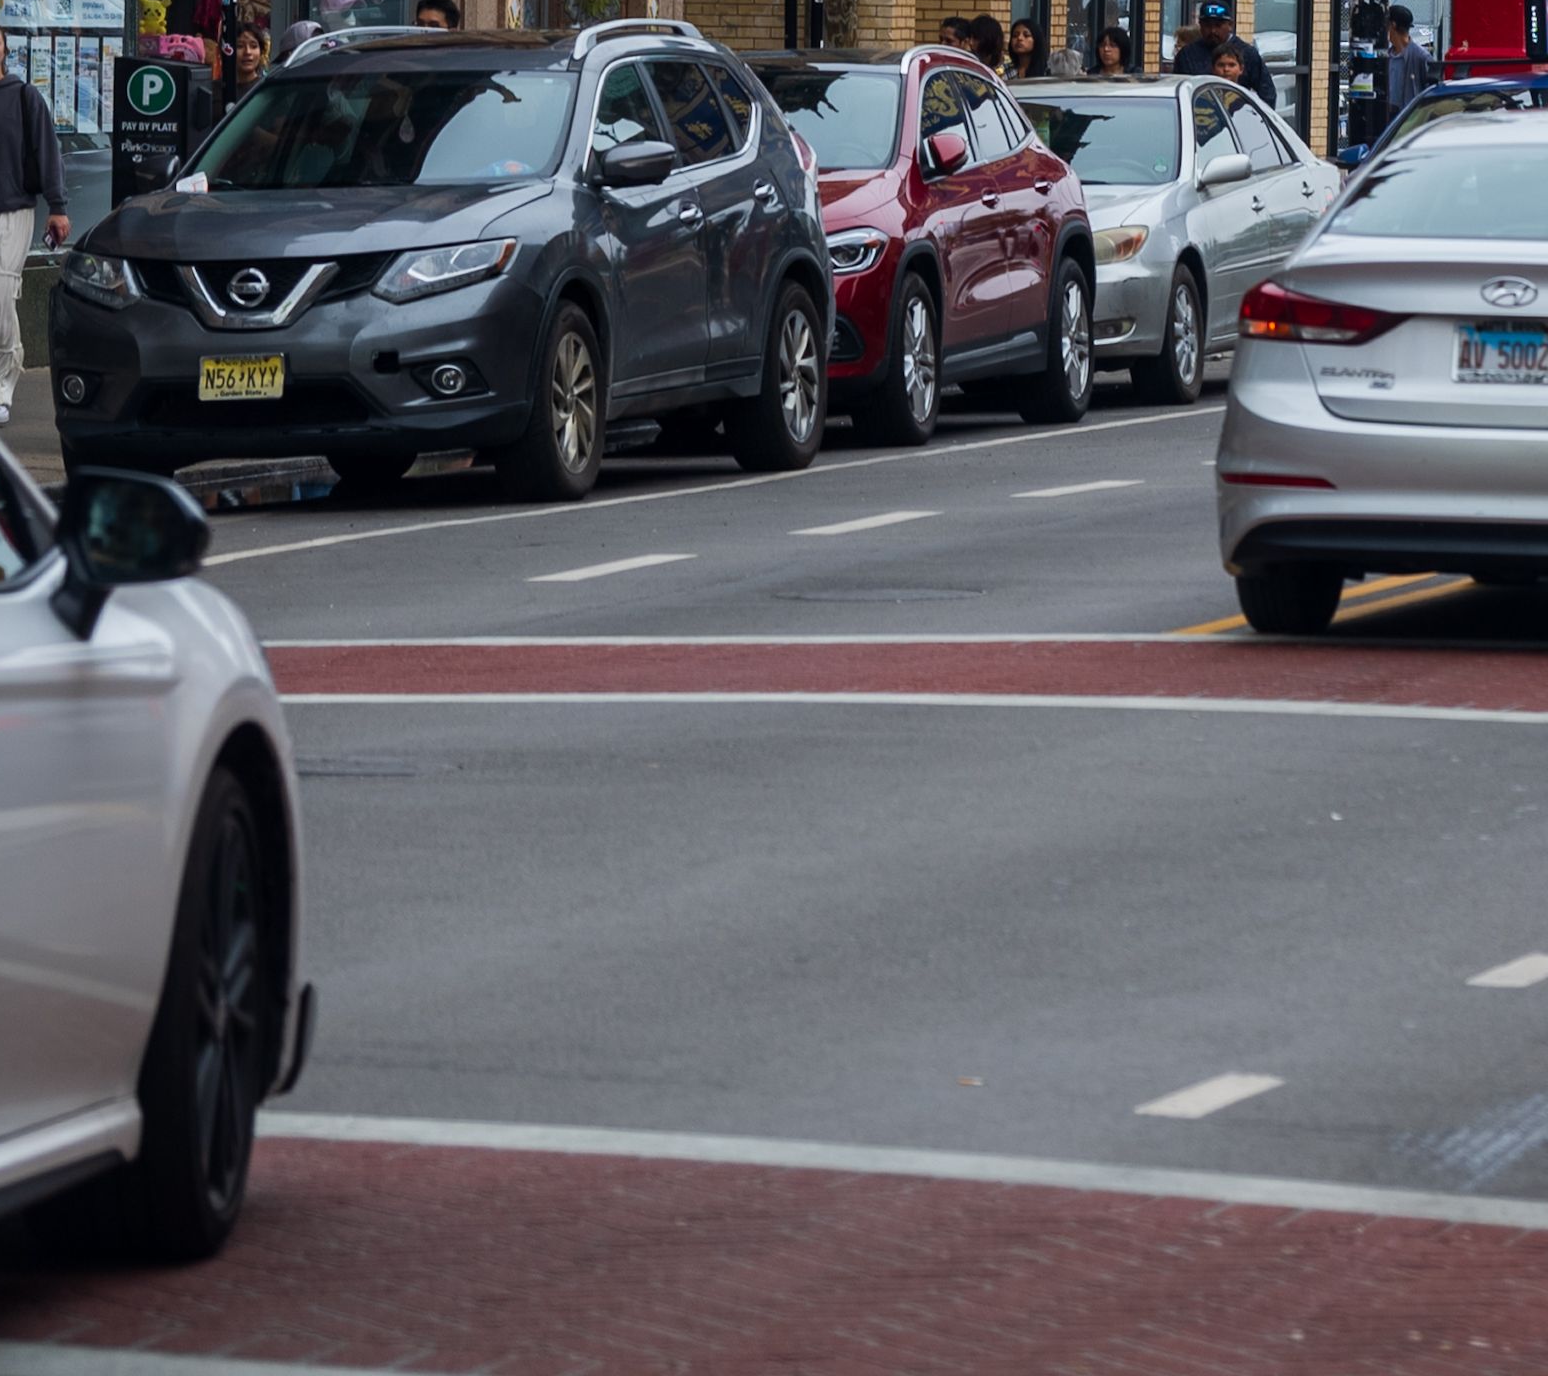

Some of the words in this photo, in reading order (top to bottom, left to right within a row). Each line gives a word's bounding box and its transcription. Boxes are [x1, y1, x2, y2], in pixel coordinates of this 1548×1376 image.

[142, 74, 163, 106] P
[122, 122, 137, 132] PAY
[139, 122, 150, 131] BY
[152, 122, 178, 132] PLATE
[1459, 340, 1486, 369] AV
[1320, 367, 1396, 379] ELANTRA
